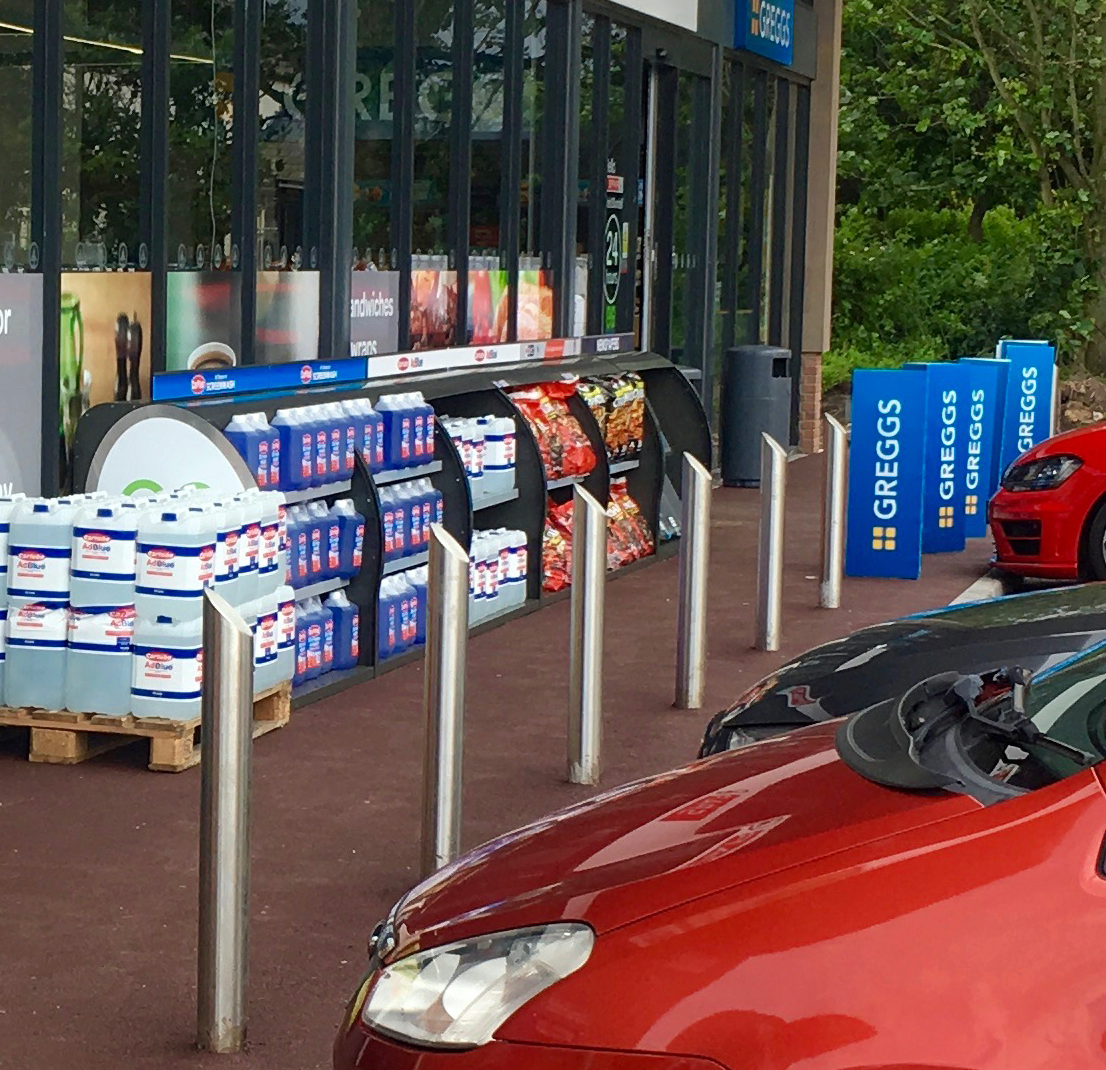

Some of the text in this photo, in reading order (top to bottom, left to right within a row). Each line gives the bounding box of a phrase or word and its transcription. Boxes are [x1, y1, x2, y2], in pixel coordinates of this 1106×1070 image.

[759, 0, 791, 48] GREGGS
[605, 230, 619, 266] 24
[350, 290, 394, 318] andwiches
[1017, 366, 1038, 453] GREGGS
[873, 399, 902, 520] GREGGS
[939, 389, 957, 500] GREGGS
[966, 389, 985, 490] GREGGS
[82, 543, 111, 552] AdBlue
[146, 559, 175, 569] AdBlue
[144, 661, 173, 671] AdBlue
